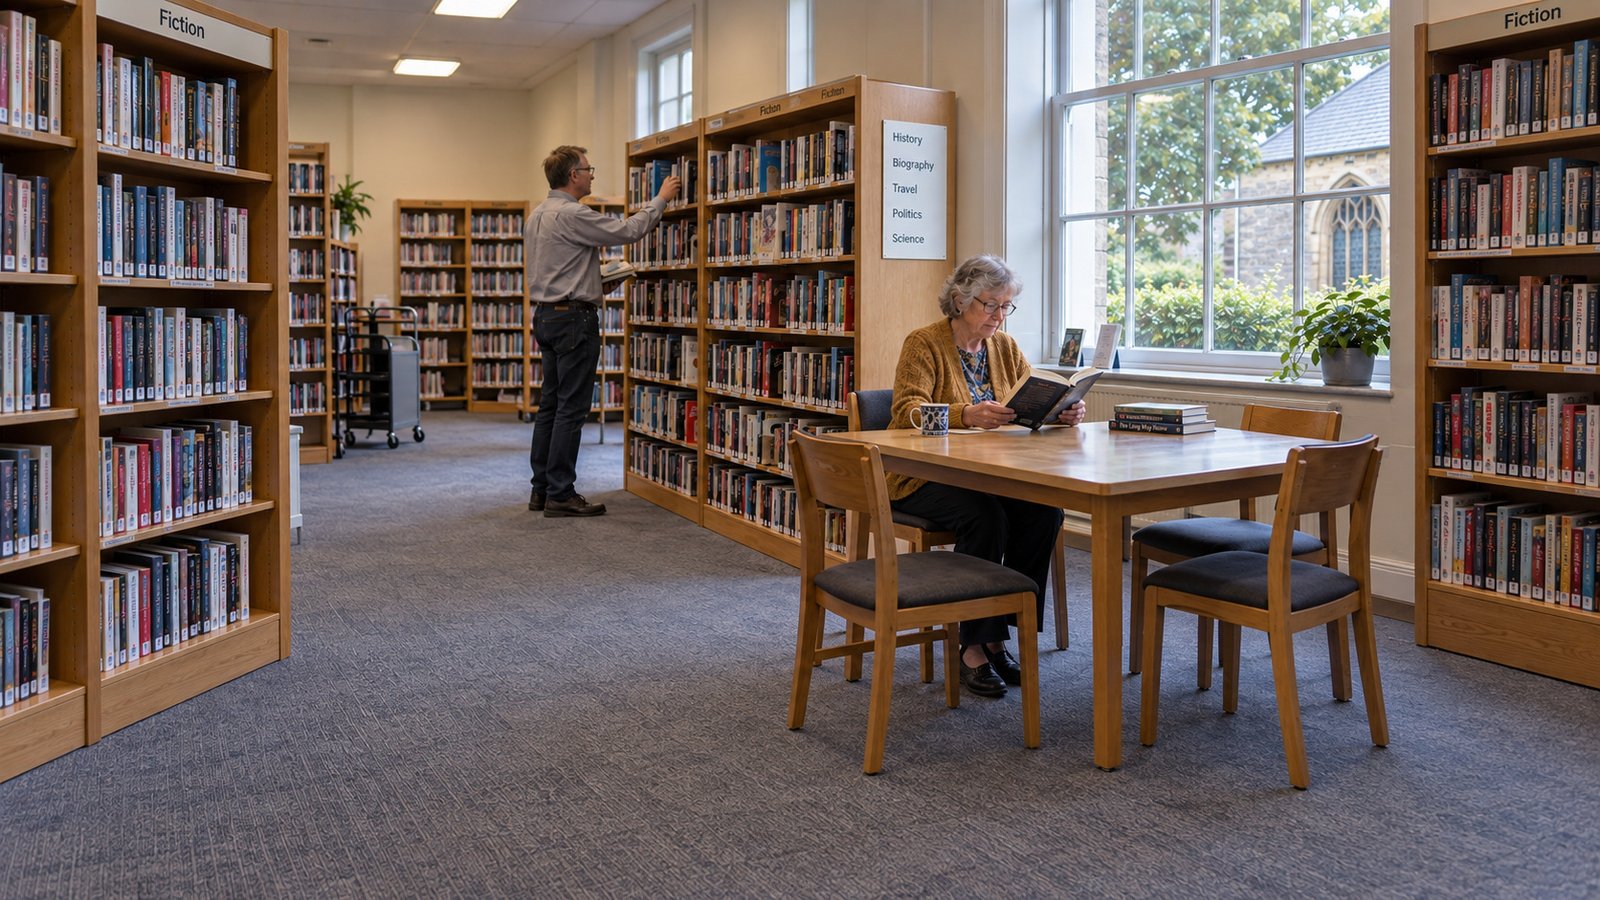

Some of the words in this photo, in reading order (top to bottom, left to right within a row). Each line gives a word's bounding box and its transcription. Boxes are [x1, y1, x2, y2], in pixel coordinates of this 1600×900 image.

[160, 8, 205, 39] Fiction
[1504, 6, 1561, 29] Fiction
[892, 132, 923, 147] History
[892, 158, 935, 172] Biography
[892, 183, 918, 194] Travel
[892, 208, 923, 219] Politics
[892, 233, 925, 244] Science
